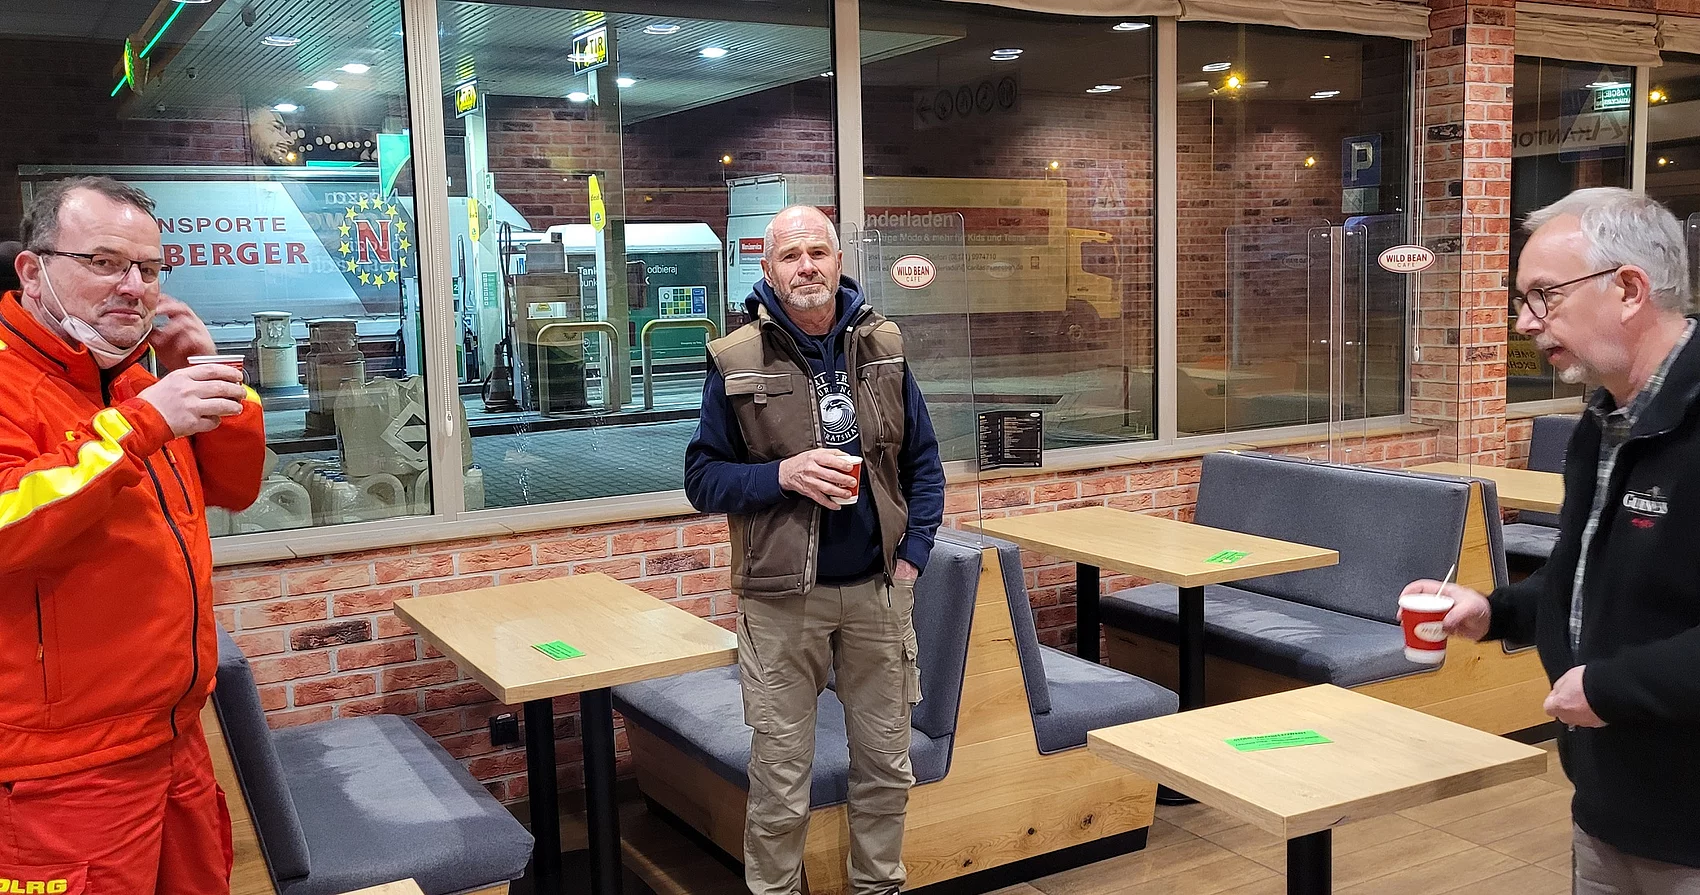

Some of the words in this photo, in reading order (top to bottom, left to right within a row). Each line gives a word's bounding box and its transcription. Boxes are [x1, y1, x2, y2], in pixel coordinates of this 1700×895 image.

[1351, 141, 1373, 181] P
[158, 217, 287, 233] NSPORTE
[866, 210, 954, 228] nderladen
[355, 219, 399, 265] N
[967, 233, 985, 241] Kids
[987, 233, 1002, 241] und
[162, 242, 310, 267] BERGER
[1386, 254, 1405, 263] WILD
[1407, 253, 1428, 262] BEAN
[646, 264, 678, 275] odbieraj
[896, 266, 912, 276] WILD
[913, 266, 930, 275] BEAN
[823, 424, 858, 442] RATSHA
[0, 878, 68, 894] DLRG
